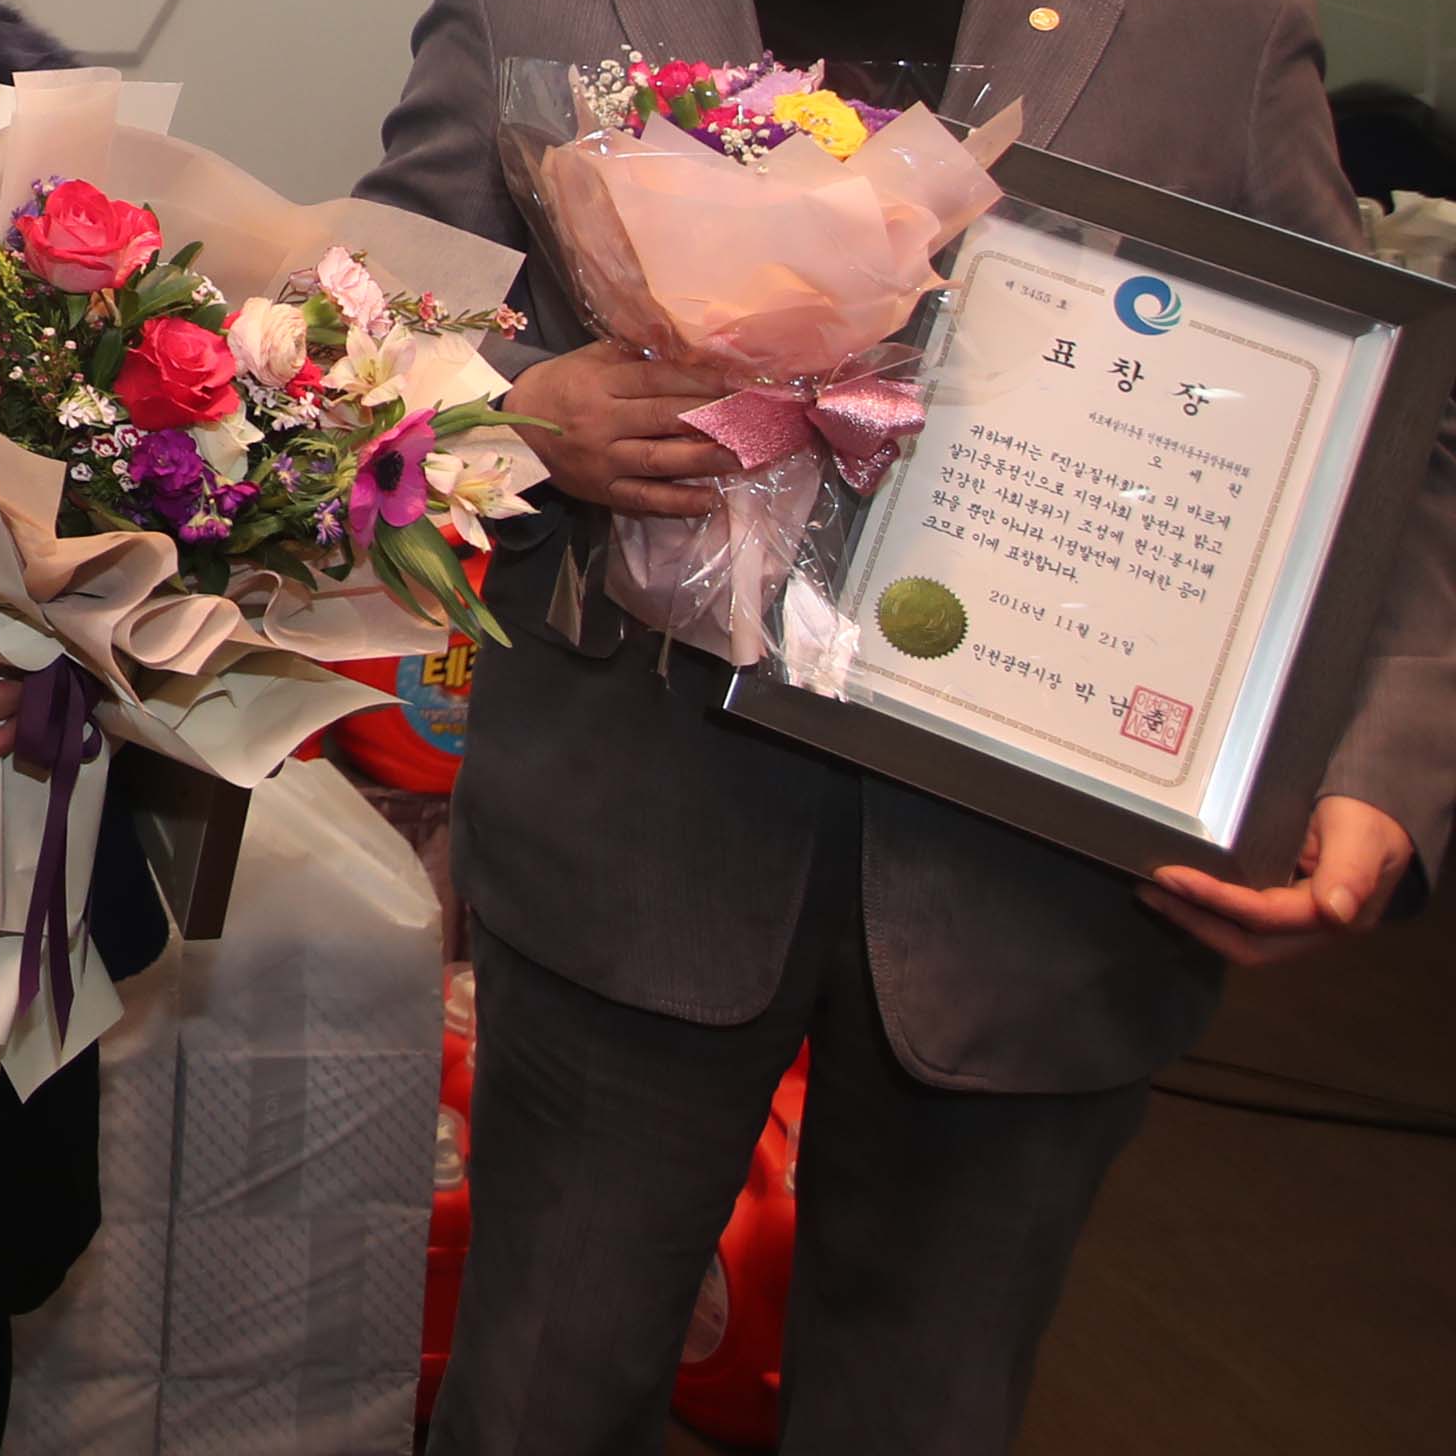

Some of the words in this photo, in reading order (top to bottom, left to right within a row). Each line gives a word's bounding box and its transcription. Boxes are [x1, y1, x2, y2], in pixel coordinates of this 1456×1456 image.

[1041, 338, 1077, 370] 표
[1106, 356, 1145, 393] 창
[1170, 381, 1210, 417] 장
[940, 466, 986, 495] 건강한
[1077, 519, 1124, 545] 조성에
[949, 443, 1065, 496] 살기운동정신으로
[1073, 489, 1132, 521] 지역사회
[1141, 513, 1185, 540] 발전과
[1193, 533, 1223, 555] 밝고
[969, 424, 1043, 461] 귀하께서는
[1163, 495, 1179, 511] 의
[1186, 504, 1231, 530] 바르게
[921, 515, 966, 540] 크므로
[972, 532, 1000, 552] 이에
[1004, 545, 1079, 584] 표창합니다.
[931, 489, 961, 513] 왔을
[967, 502, 995, 525] 뿐만
[1001, 517, 1044, 542] 아니라
[1050, 534, 1121, 571] 시정발전에
[1127, 563, 1172, 592] 기여한
[1177, 581, 1207, 603] 공이
[988, 589, 1046, 622] 2018년
[1055, 614, 1091, 639] 11월
[1098, 631, 1136, 657] 21일
[972, 642, 1063, 691] 인천광역시장
[1074, 680, 1096, 704] 박
[1109, 694, 1132, 718] 남
